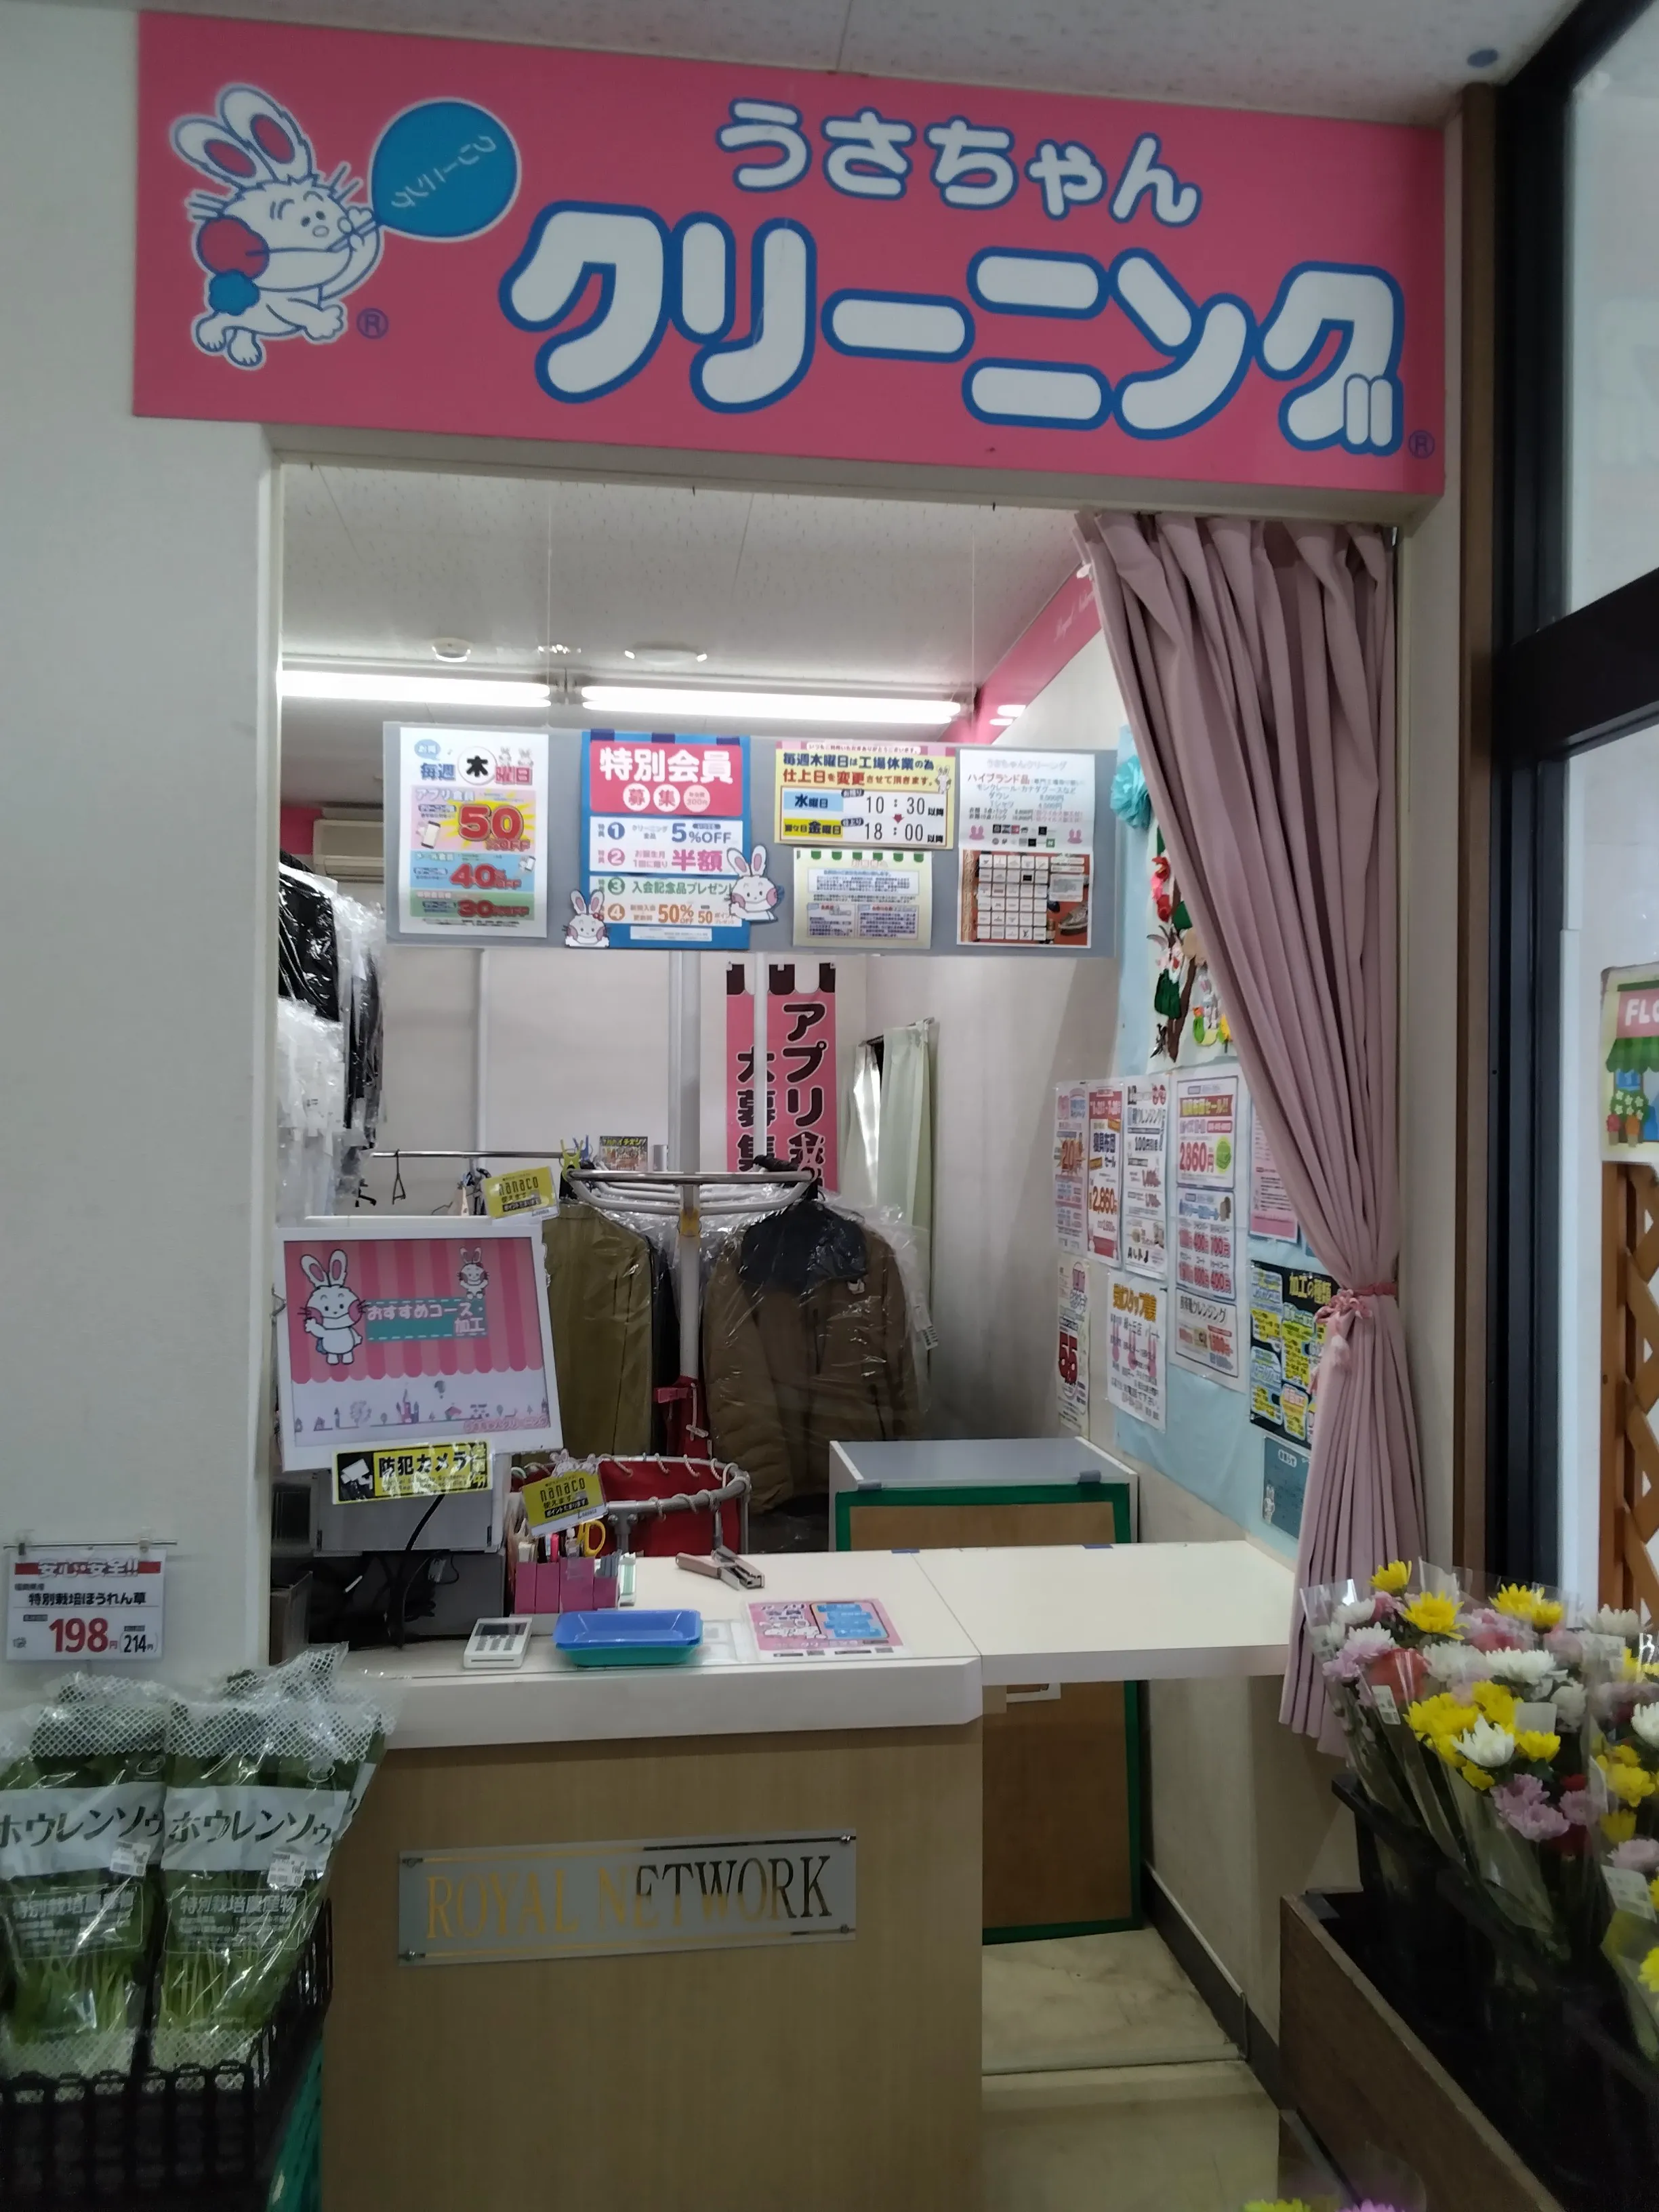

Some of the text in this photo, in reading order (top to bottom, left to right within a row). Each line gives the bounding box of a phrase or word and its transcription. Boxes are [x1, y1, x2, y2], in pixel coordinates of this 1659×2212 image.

[716, 98, 1202, 226] うさちゃん
[499, 200, 1403, 455] クリーニング
[600, 747, 733, 784] 特別会員
[783, 753, 934, 771] 毎週木曜日は工場休業の為
[783, 769, 932, 785] 仕上日を変更させて頂きます。
[968, 773, 1030, 785] ハイブランド品
[795, 794, 827, 808] 水曜日
[458, 804, 525, 842] 50
[672, 849, 723, 872] 半額
[449, 863, 497, 888] 40
[454, 1318, 485, 1333] 加工
[379, 1452, 469, 1478] 防犯カメラ
[539, 1477, 586, 1502] nanaco
[28, 1592, 146, 1606] 特別栽培ほうれん草
[426, 1856, 832, 1939] ROYAL NETWORK
